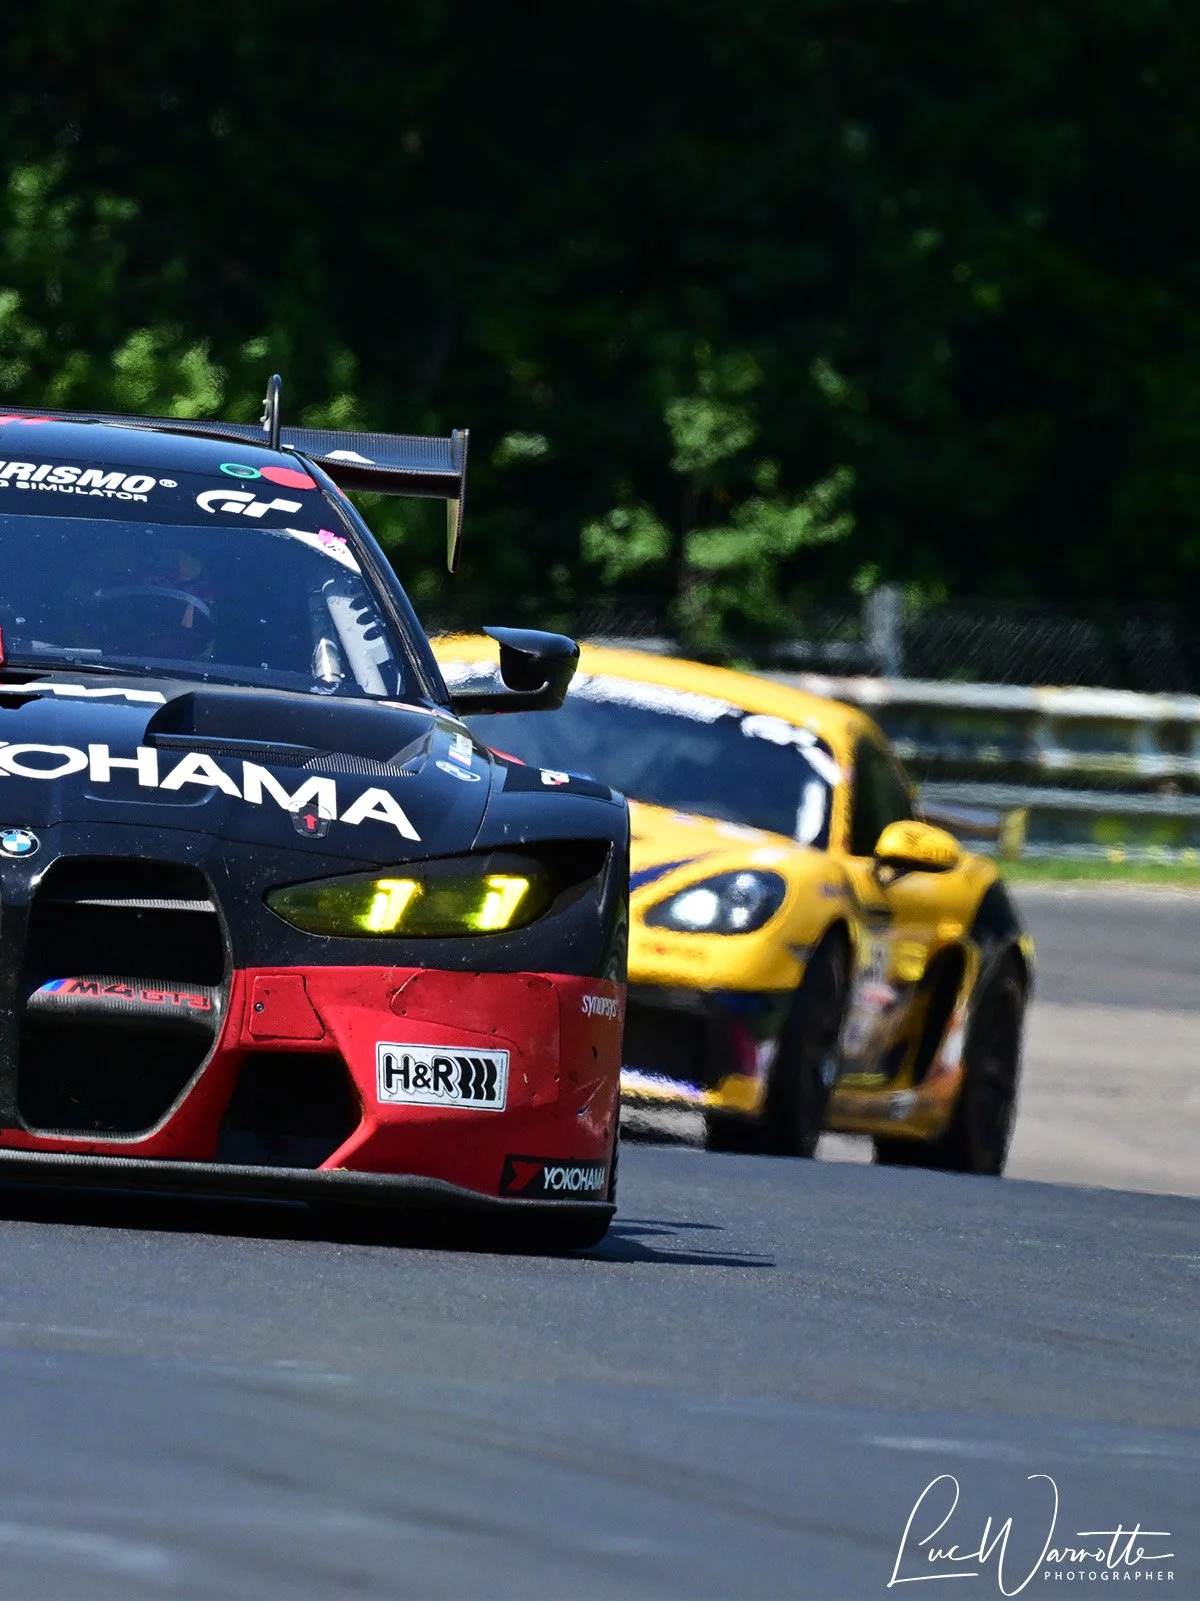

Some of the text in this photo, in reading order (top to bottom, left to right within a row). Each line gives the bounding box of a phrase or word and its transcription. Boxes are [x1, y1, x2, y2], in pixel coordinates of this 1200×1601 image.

[16, 481, 149, 503] SIMULATOR
[68, 980, 211, 1011] M4 GT3
[384, 1054, 455, 1094] H&R
